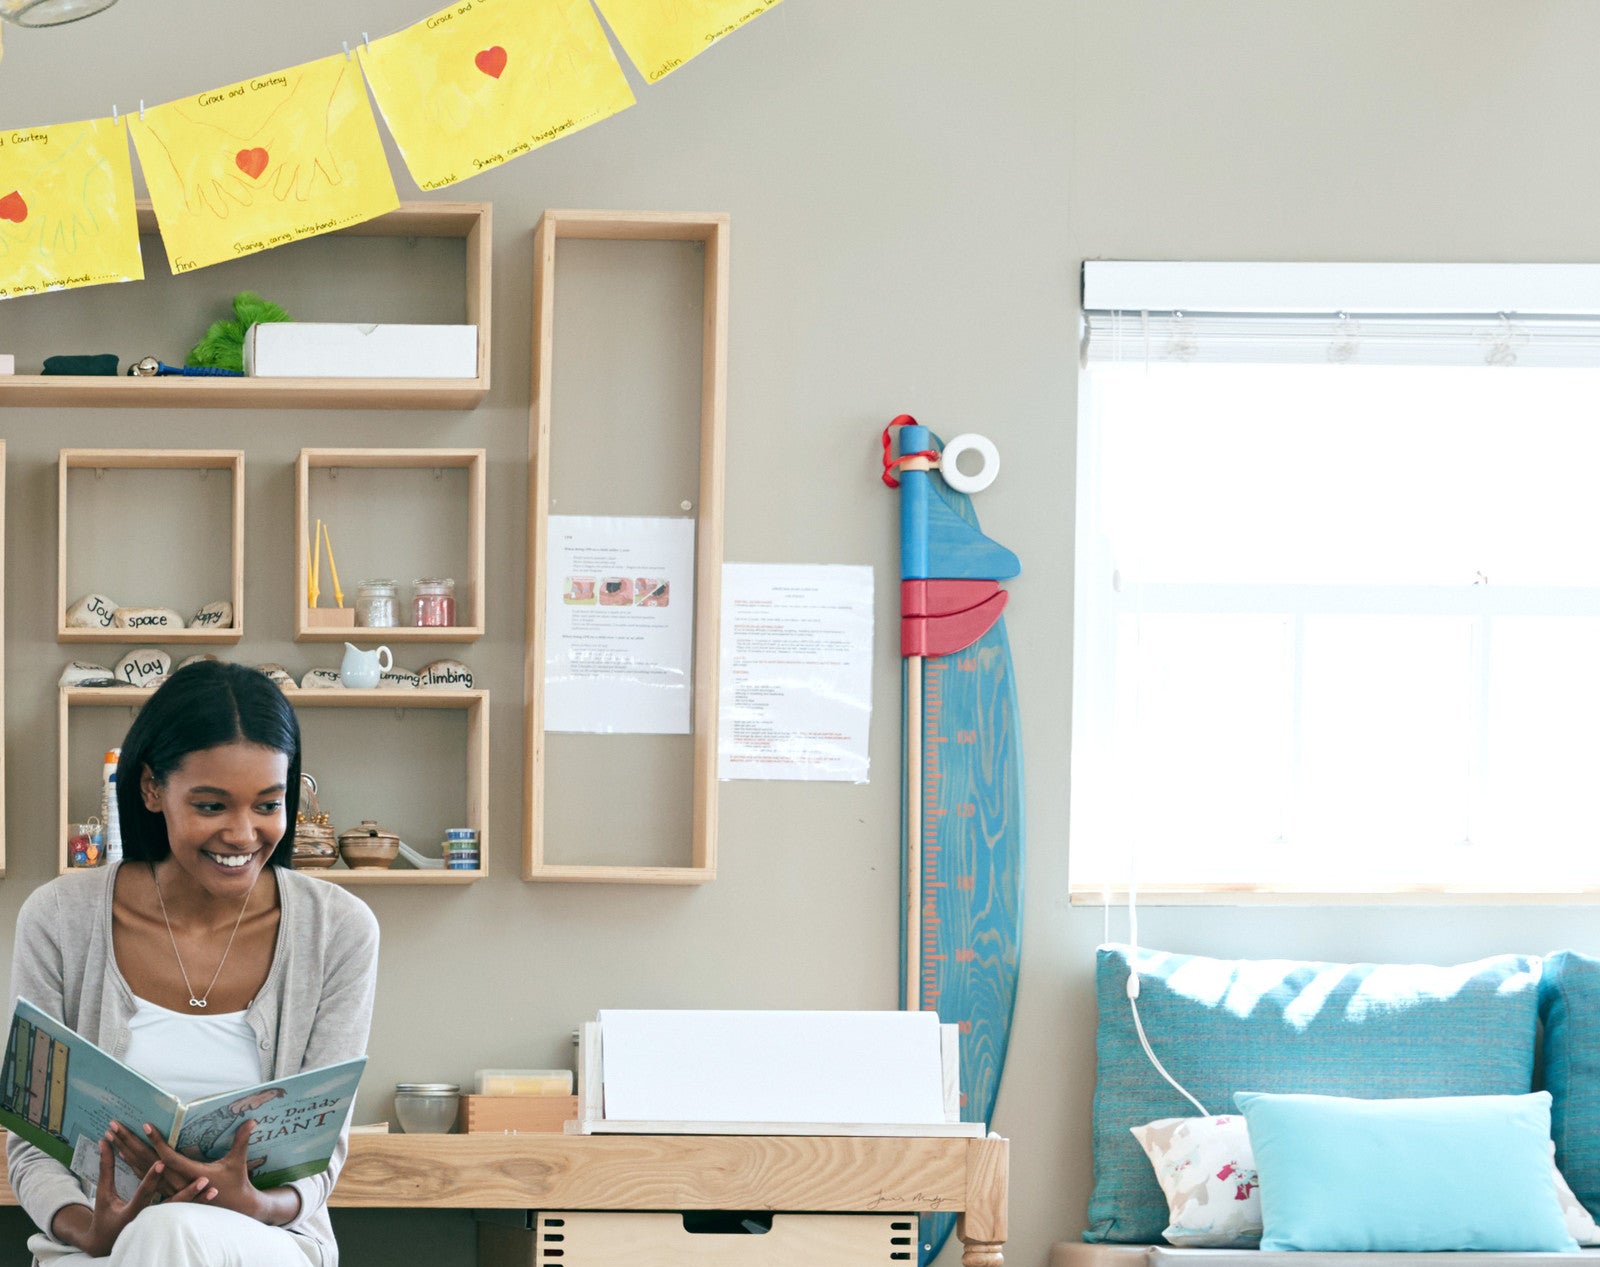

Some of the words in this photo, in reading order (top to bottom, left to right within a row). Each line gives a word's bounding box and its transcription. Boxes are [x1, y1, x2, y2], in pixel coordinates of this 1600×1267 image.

[426, 13, 453, 29] Grace
[457, 4, 472, 15] and
[649, 58, 682, 81] Caitlin
[198, 93, 224, 107] Grace
[228, 86, 245, 98] and
[250, 76, 287, 92] Courtesy
[11, 133, 48, 145] Courtesy
[174, 256, 197, 273] Finn
[87, 597, 114, 627] Joy
[128, 615, 167, 629] space
[124, 658, 163, 683] Play
[957, 658, 977, 672] 140
[421, 667, 473, 688] climbing
[957, 730, 977, 745] 130
[957, 803, 976, 817] 120
[956, 876, 975, 890] 110
[955, 948, 975, 962] 100
[255, 1115, 279, 1125] My
[285, 1097, 341, 1117] Daddy
[248, 1110, 336, 1145] GIANT
